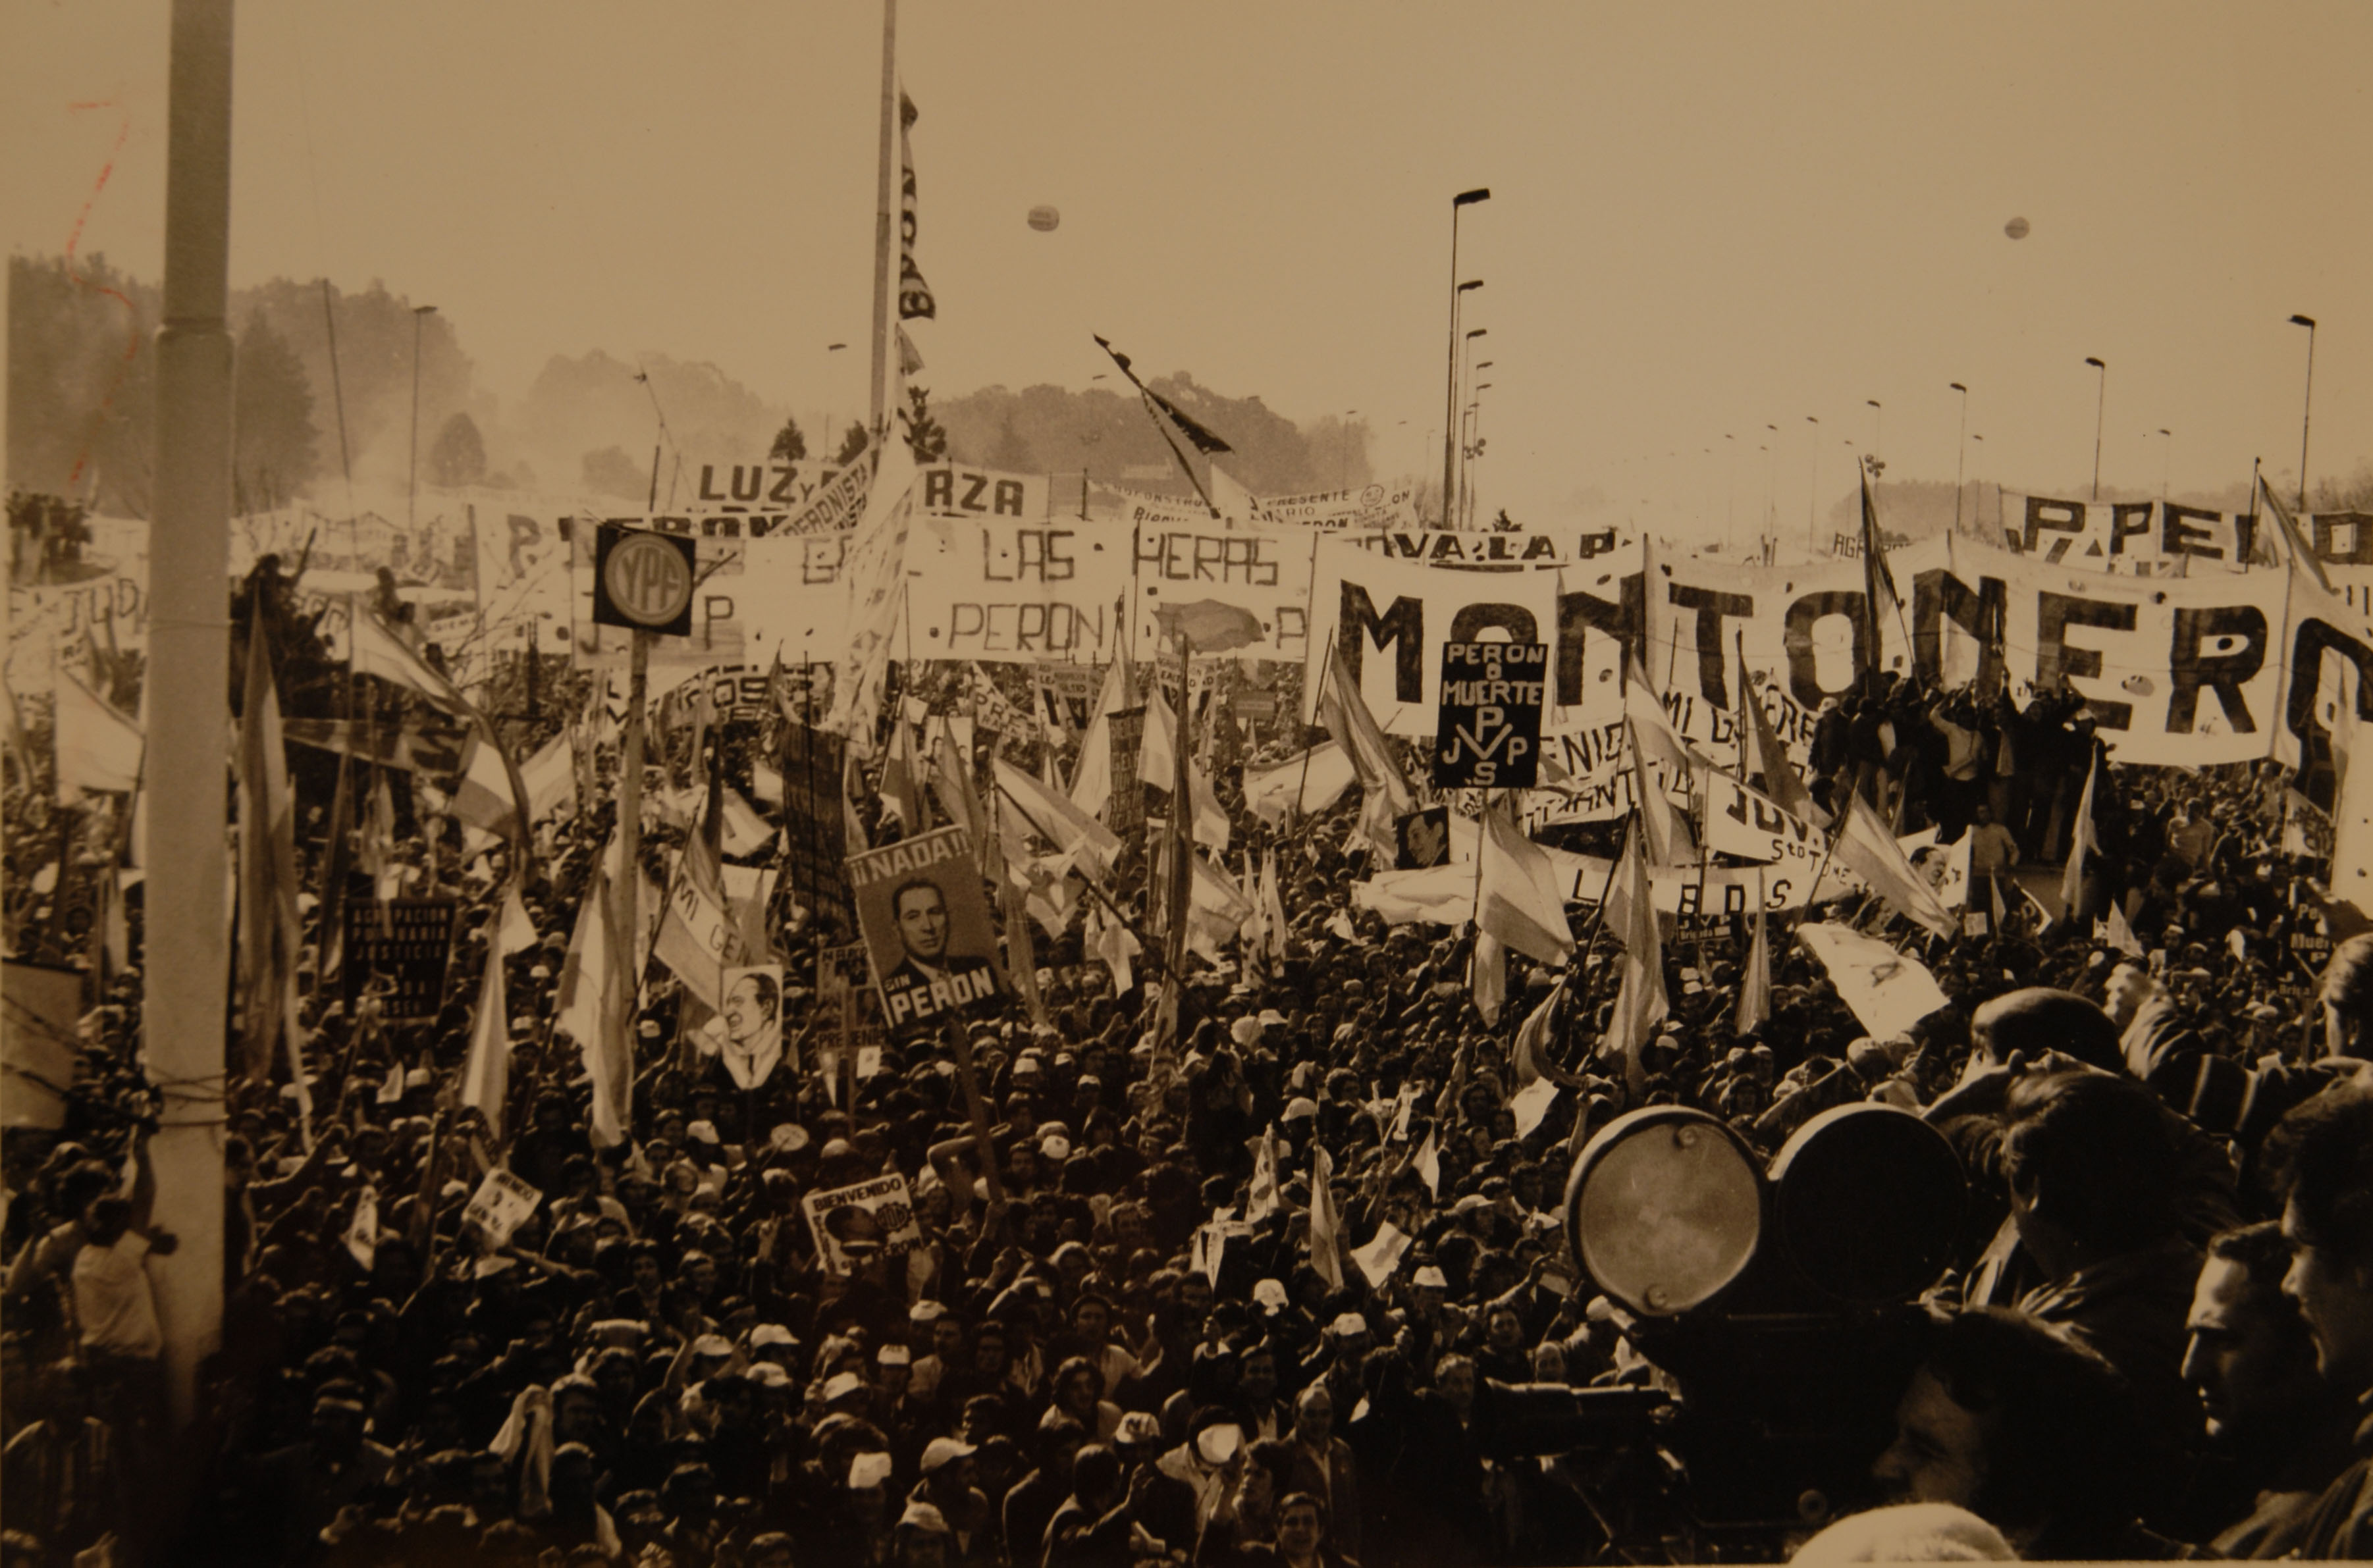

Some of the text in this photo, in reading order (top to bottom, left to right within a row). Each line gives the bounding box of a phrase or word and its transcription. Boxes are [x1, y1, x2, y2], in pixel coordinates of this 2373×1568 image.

[699, 464, 798, 503] LUZ
[799, 481, 816, 504] Y
[983, 529, 1075, 583] LAS
[1131, 531, 1279, 587] HERAS
[948, 603, 1104, 651] PERON
[1447, 643, 1545, 666] PERON
[1485, 662, 1503, 681] O
[1441, 679, 1545, 706] MUERTE
[1475, 706, 1505, 743] P
[1442, 737, 1461, 764] J
[1506, 736, 1528, 766] P
[890, 966, 995, 1024] PERON
[813, 1178, 901, 1212] BIENVENIDO
